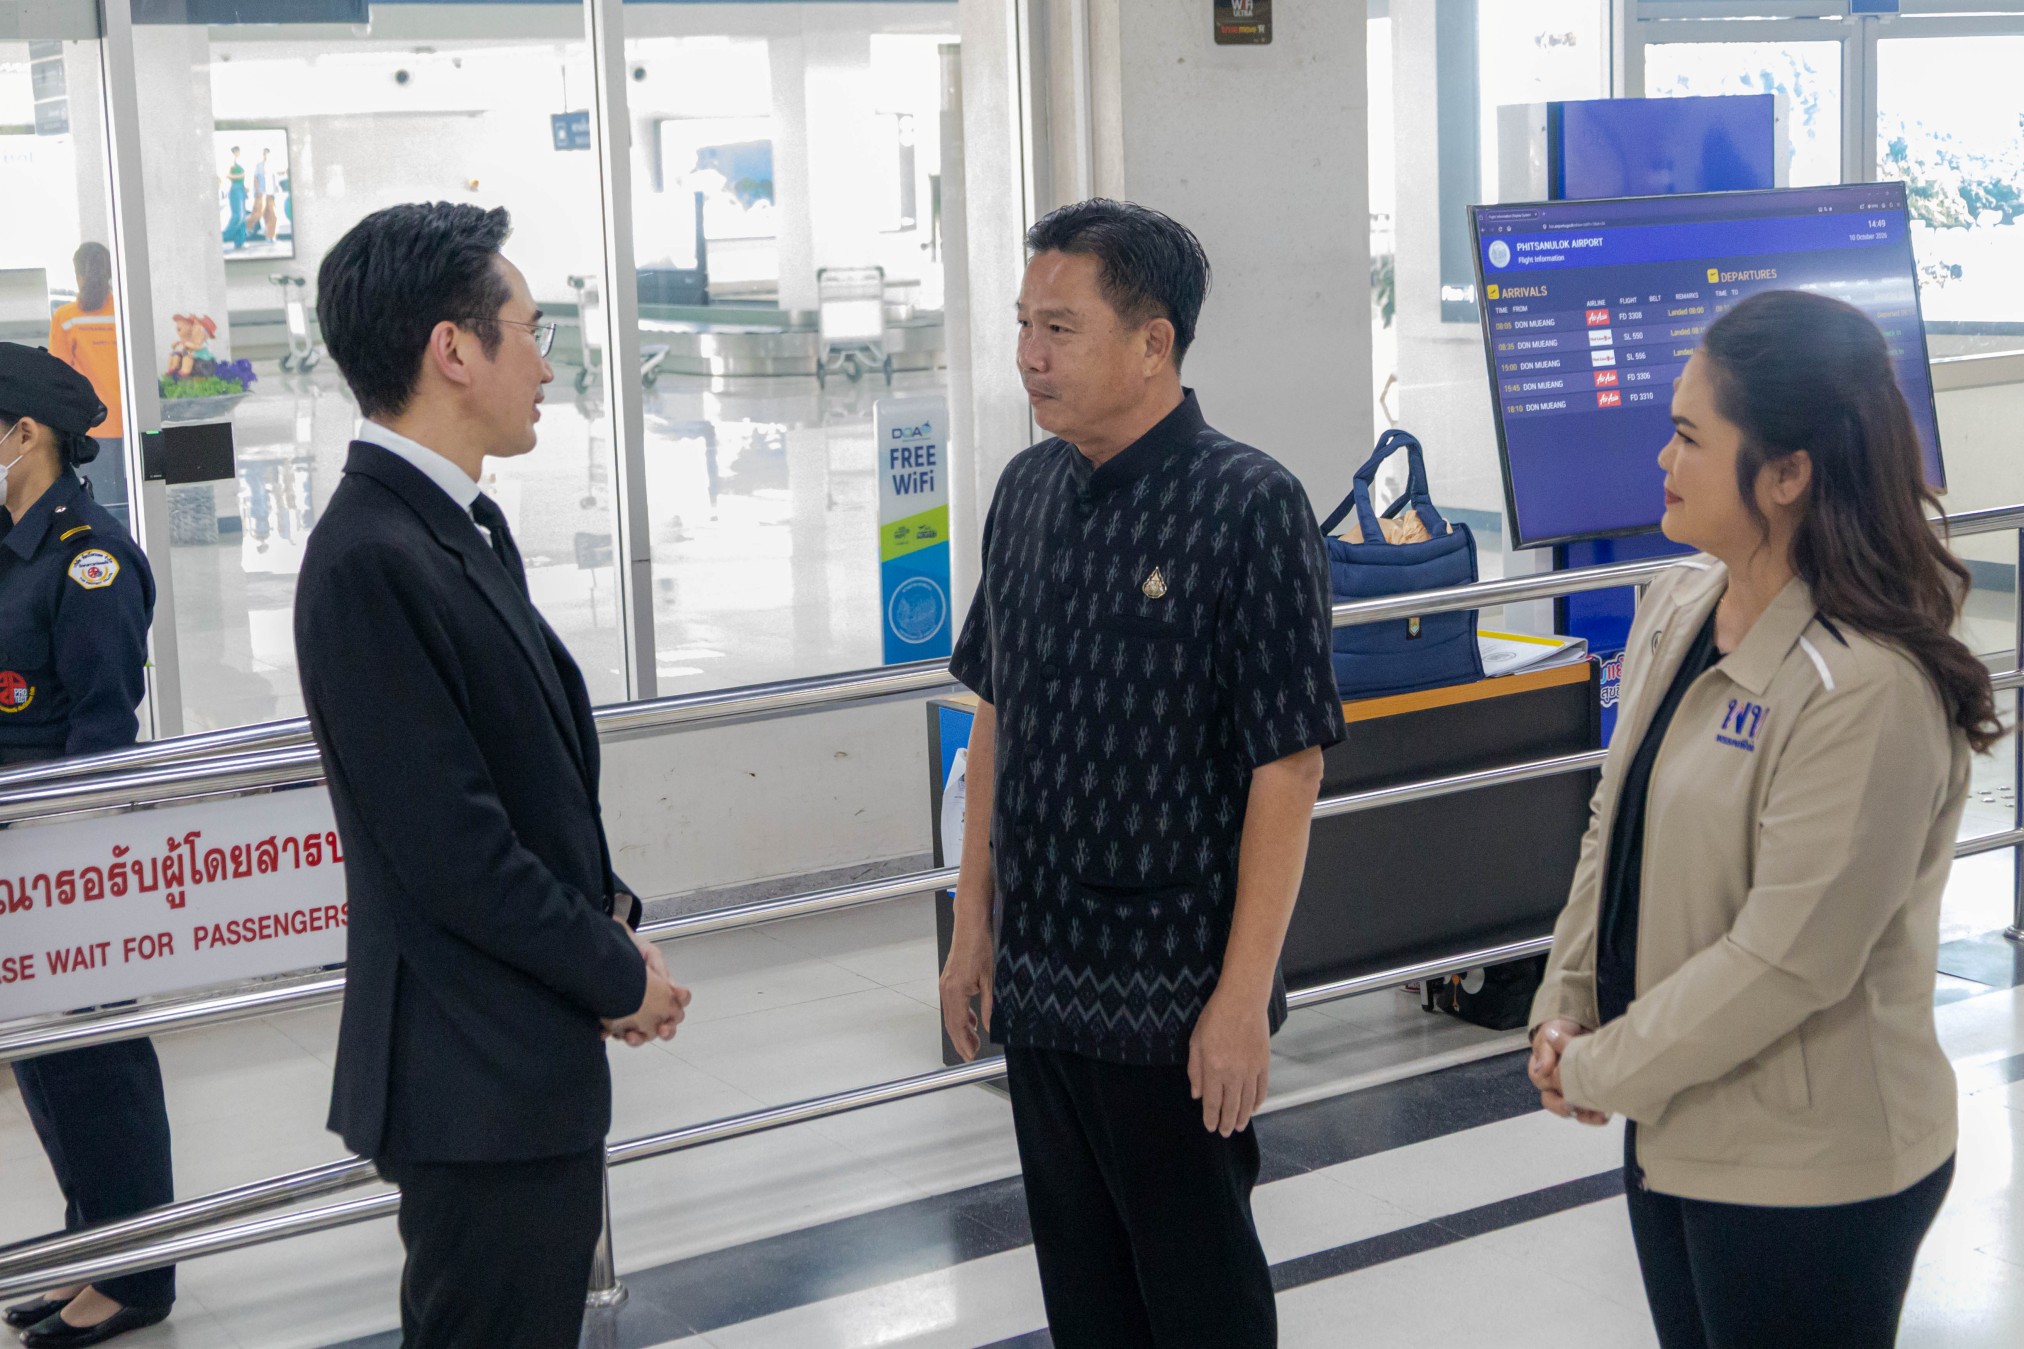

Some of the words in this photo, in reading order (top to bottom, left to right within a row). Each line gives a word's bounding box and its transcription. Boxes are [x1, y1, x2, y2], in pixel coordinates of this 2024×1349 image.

[1868, 219, 1886, 229] 14:49
[1516, 239, 1570, 252] PHITSANULOK
[1571, 237, 1604, 249] AIRPORT
[1518, 256, 1533, 265] Flight
[1534, 254, 1565, 263] Information
[1721, 268, 1777, 283] DEPARTURES
[1501, 285, 1548, 299] ARRIVALS
[1495, 306, 1508, 314] TIME
[1512, 305, 1528, 313] FROM
[1586, 299, 1606, 307] AIRLINE
[1619, 296, 1637, 305] FLIGHT
[1514, 321, 1528, 329] DON
[1618, 313, 1628, 321] FD
[1517, 341, 1531, 350] DON
[1520, 362, 1534, 370] DON
[1523, 382, 1537, 391] DON
[1627, 373, 1636, 381] FD
[1525, 403, 1539, 412] DON
[1630, 393, 1639, 401] FD
[889, 444, 937, 470] FREE
[892, 469, 935, 496] WiFi
[0, 954, 36, 985] SE
[46, 941, 111, 976] WAIT
[123, 931, 175, 963] FOR
